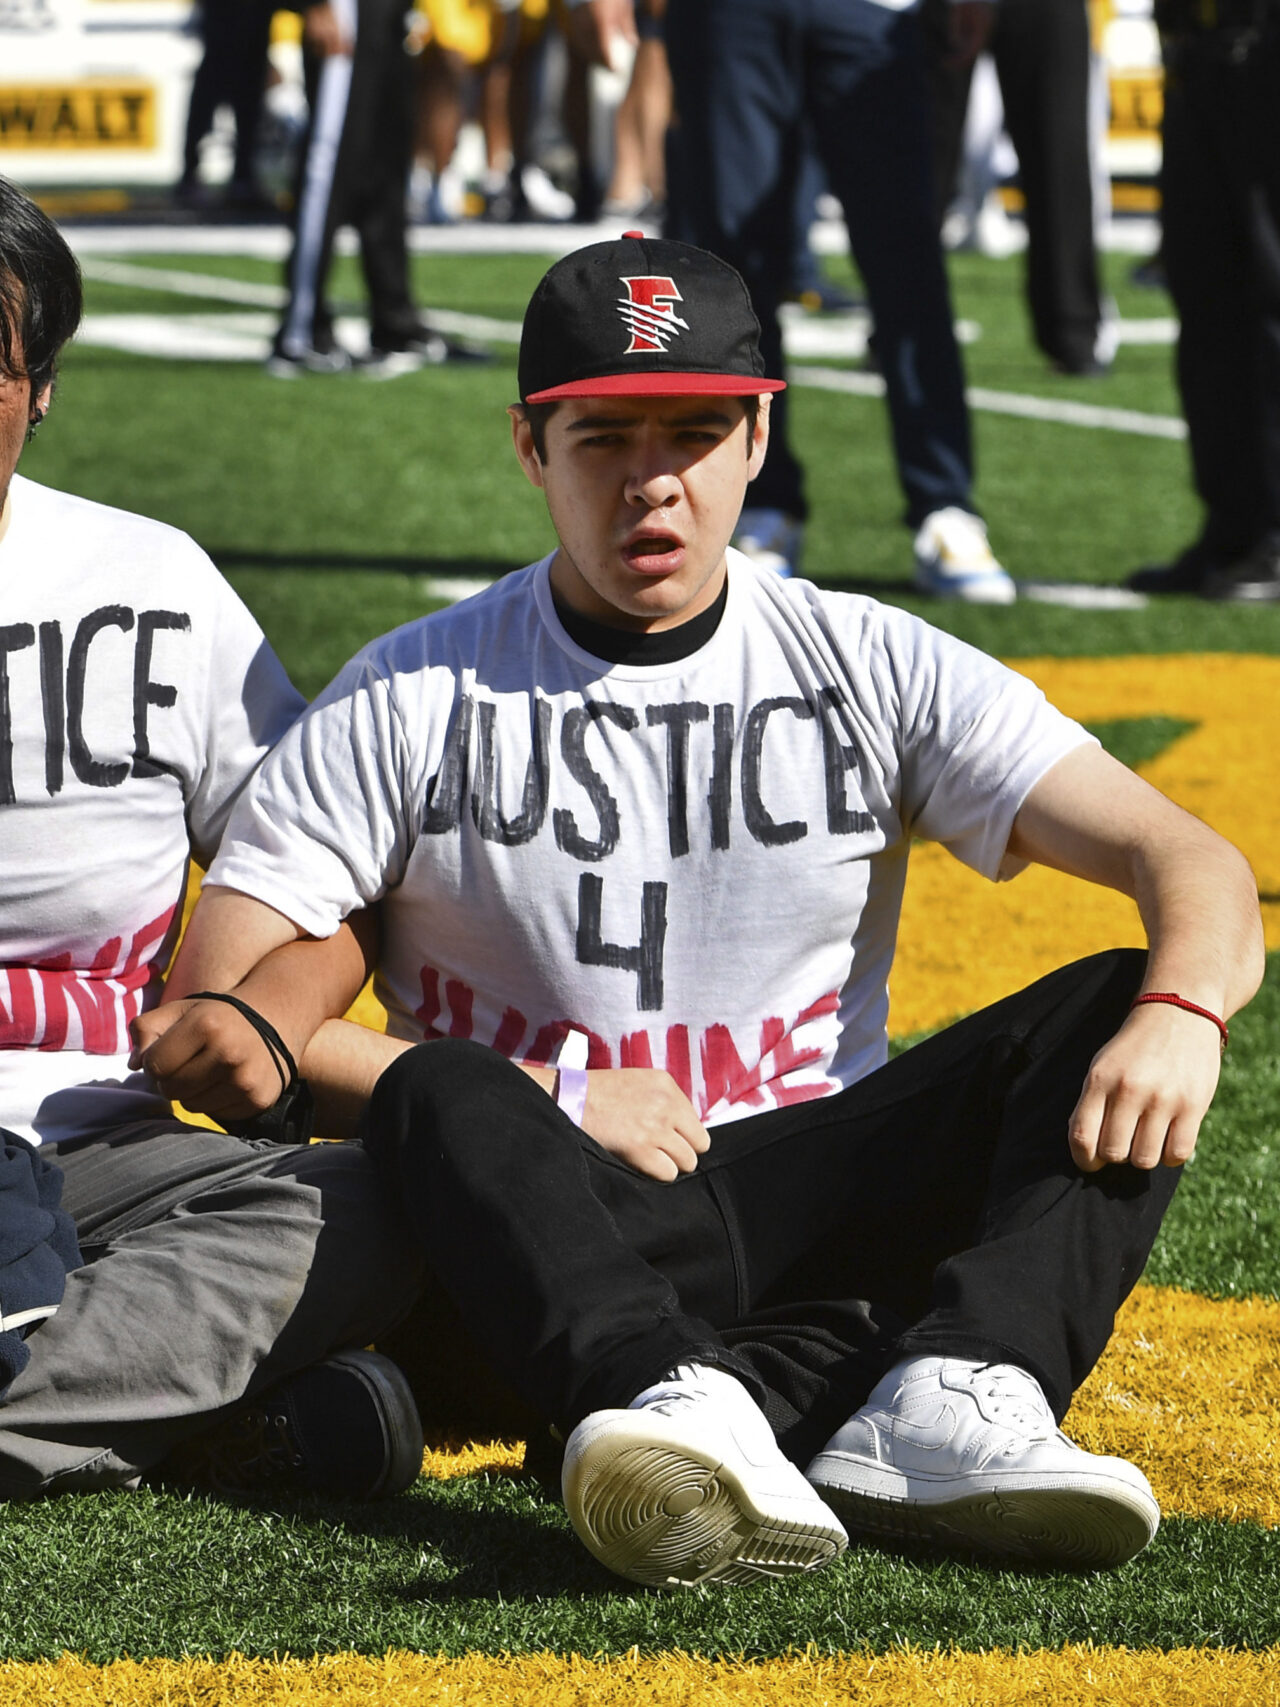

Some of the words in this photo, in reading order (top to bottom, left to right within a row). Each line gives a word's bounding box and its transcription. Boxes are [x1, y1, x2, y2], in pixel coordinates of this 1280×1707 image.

[617, 276, 689, 354] F
[420, 685, 876, 862] JUSTICE
[576, 872, 668, 1011] 4
